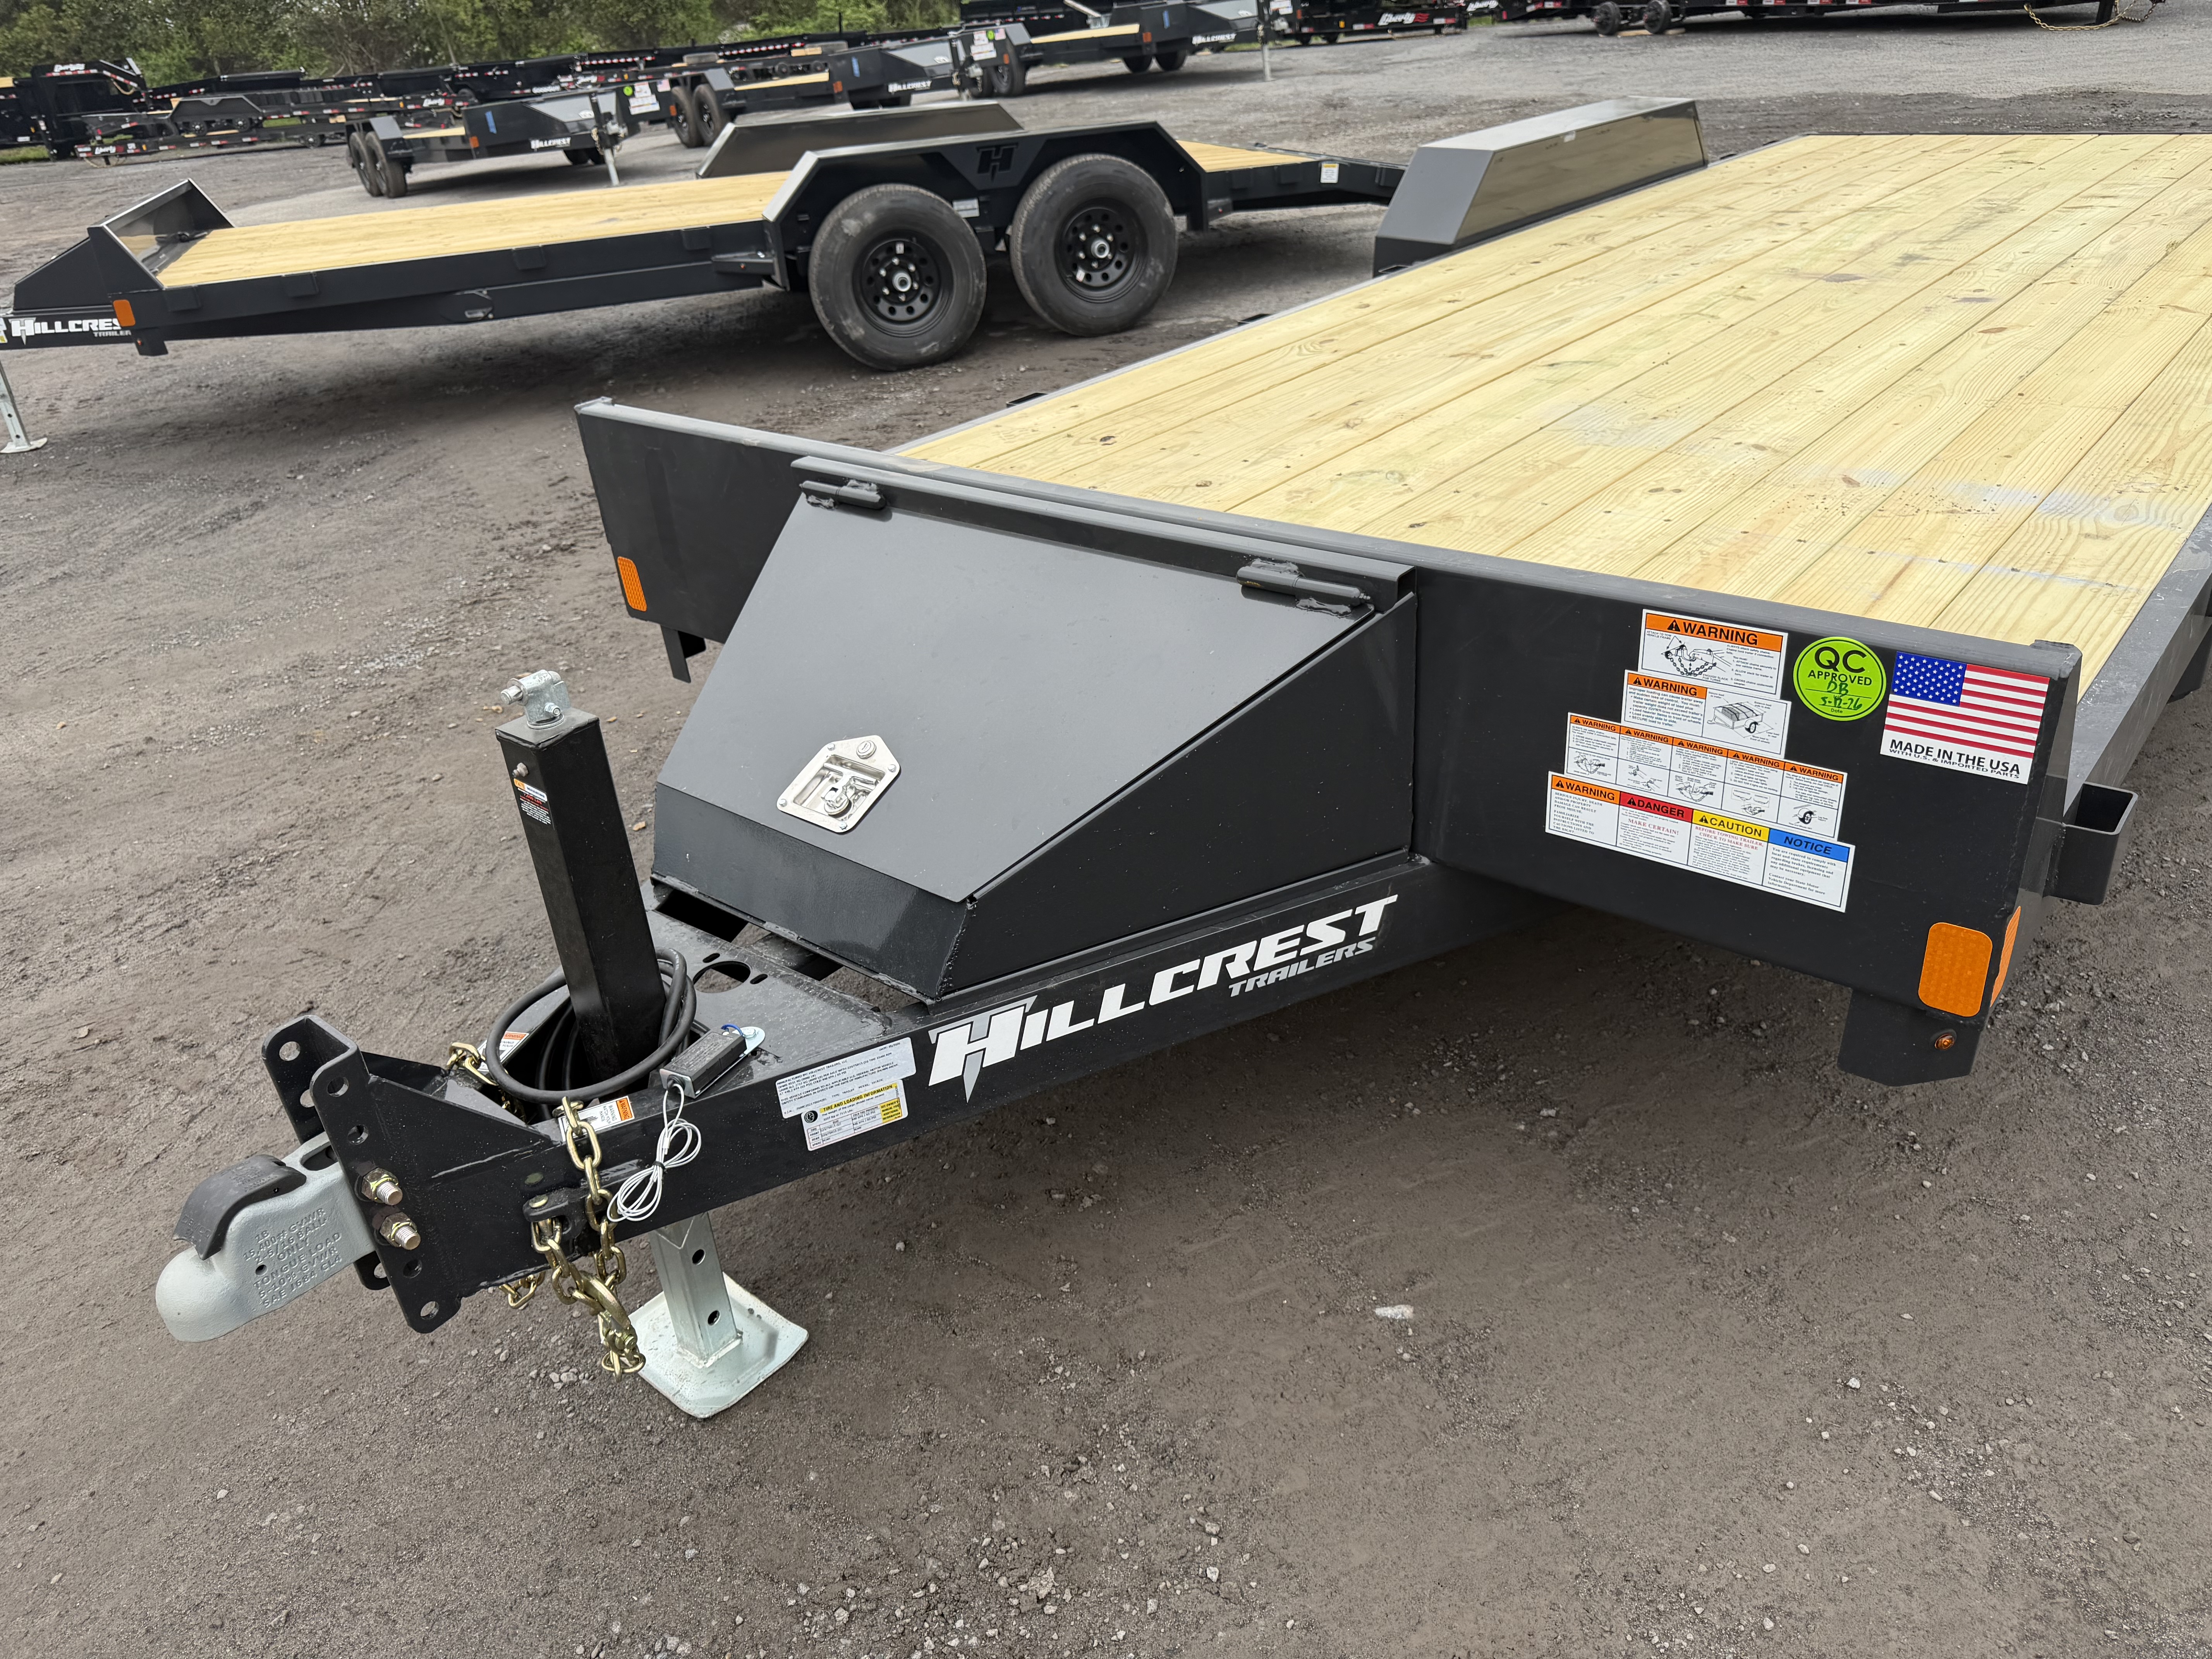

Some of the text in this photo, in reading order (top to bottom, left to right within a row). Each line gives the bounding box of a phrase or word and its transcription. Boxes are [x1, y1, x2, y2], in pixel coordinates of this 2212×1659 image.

[8, 317, 122, 345] HILLCRES
[1682, 622, 1758, 645] WARNING
[1815, 646, 1867, 673] QC
[1643, 678, 1697, 696] WARNING
[1808, 670, 1872, 685] APPROVED
[1582, 719, 1616, 731] WARNING
[1633, 730, 1668, 742] WARNING
[1686, 742, 1723, 754] WARNING
[1890, 739, 2020, 774] MADE IN THE USA
[1742, 754, 1780, 767] WARNING
[1941, 759, 1988, 772] IMPORTED
[1991, 770, 2019, 778] PARTS
[1799, 767, 1838, 781] WARNING
[1565, 781, 1614, 801] WARNING
[1637, 799, 1684, 817] DANGER
[1628, 818, 1647, 827] MAKE
[1648, 823, 1678, 835] CERTAIN!
[1695, 826, 1716, 834] BEFORE
[1717, 831, 1738, 840] TOWING
[1709, 817, 1762, 837] CAUTION
[1784, 836, 1832, 855] NOTICE
[1228, 937, 1377, 997] TRAILERS
[929, 895, 1398, 1103] HILLCREST
[844, 1095, 863, 1104] LOADING
[864, 1085, 893, 1098] INFORMATION
[620, 1102, 630, 1119] WARNING
[289, 1208, 326, 1233] GVWR
[297, 1219, 326, 1240] BALL
[278, 1238, 309, 1261] ONLY
[254, 1233, 342, 1289] TONGUE LOAD
[263, 1290, 287, 1309] SAE
